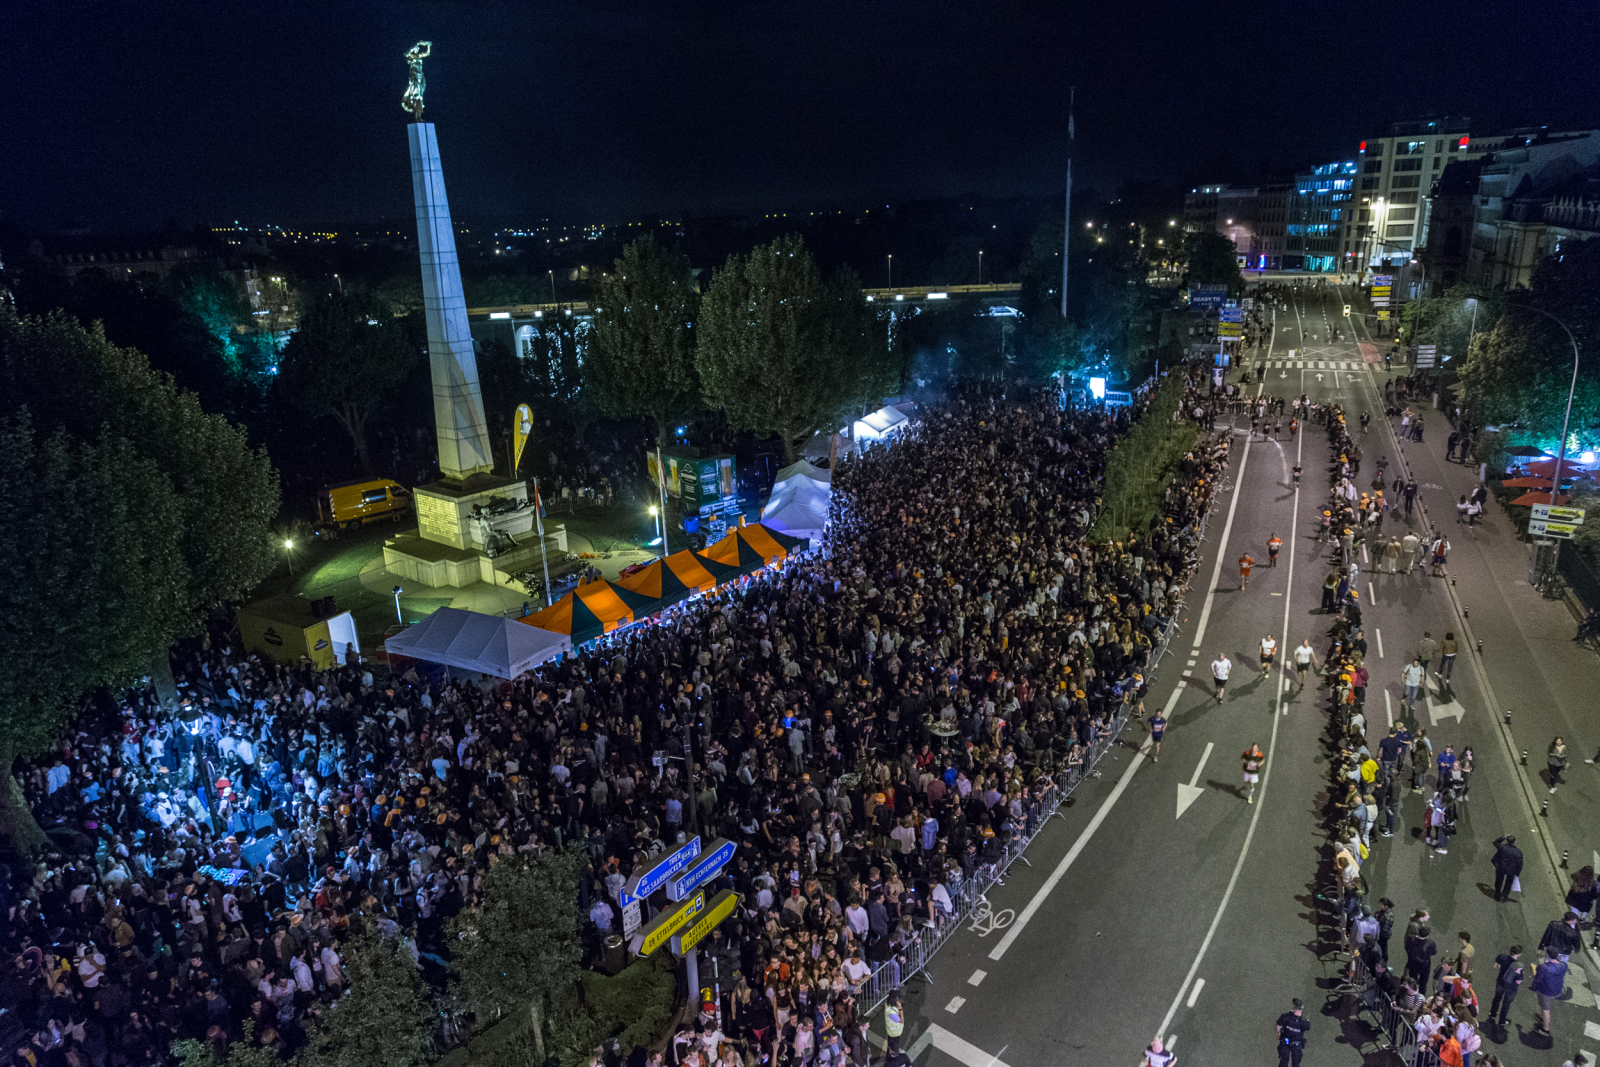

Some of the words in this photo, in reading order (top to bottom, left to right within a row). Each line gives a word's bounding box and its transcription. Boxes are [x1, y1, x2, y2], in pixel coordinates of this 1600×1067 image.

[668, 852, 682, 866] TRIER
[696, 856, 722, 880] ECHTERNACH
[641, 885, 651, 896] 145
[656, 913, 684, 941] ETTELBRUCK
[684, 922, 713, 952] DIRECTIONS
[688, 917, 708, 939] AUTRES
[1286, 1025, 1301, 1033] POLICE
